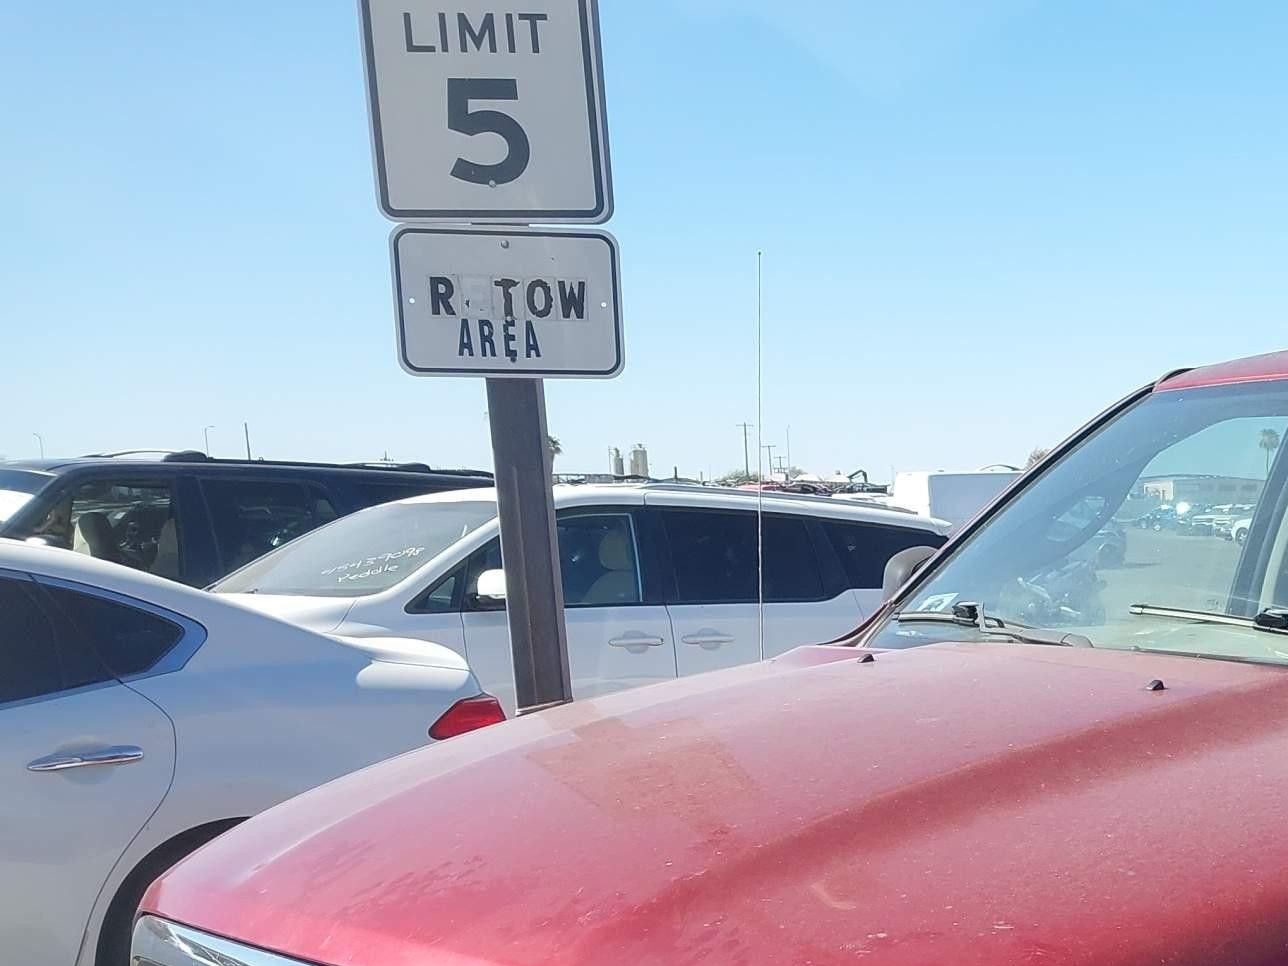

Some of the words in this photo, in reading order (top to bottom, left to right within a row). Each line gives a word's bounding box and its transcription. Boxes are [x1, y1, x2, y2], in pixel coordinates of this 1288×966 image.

[402, 12, 548, 54] LIMIT
[446, 77, 531, 187] 5
[494, 277, 586, 321] TOW
[457, 318, 542, 359] AREA
